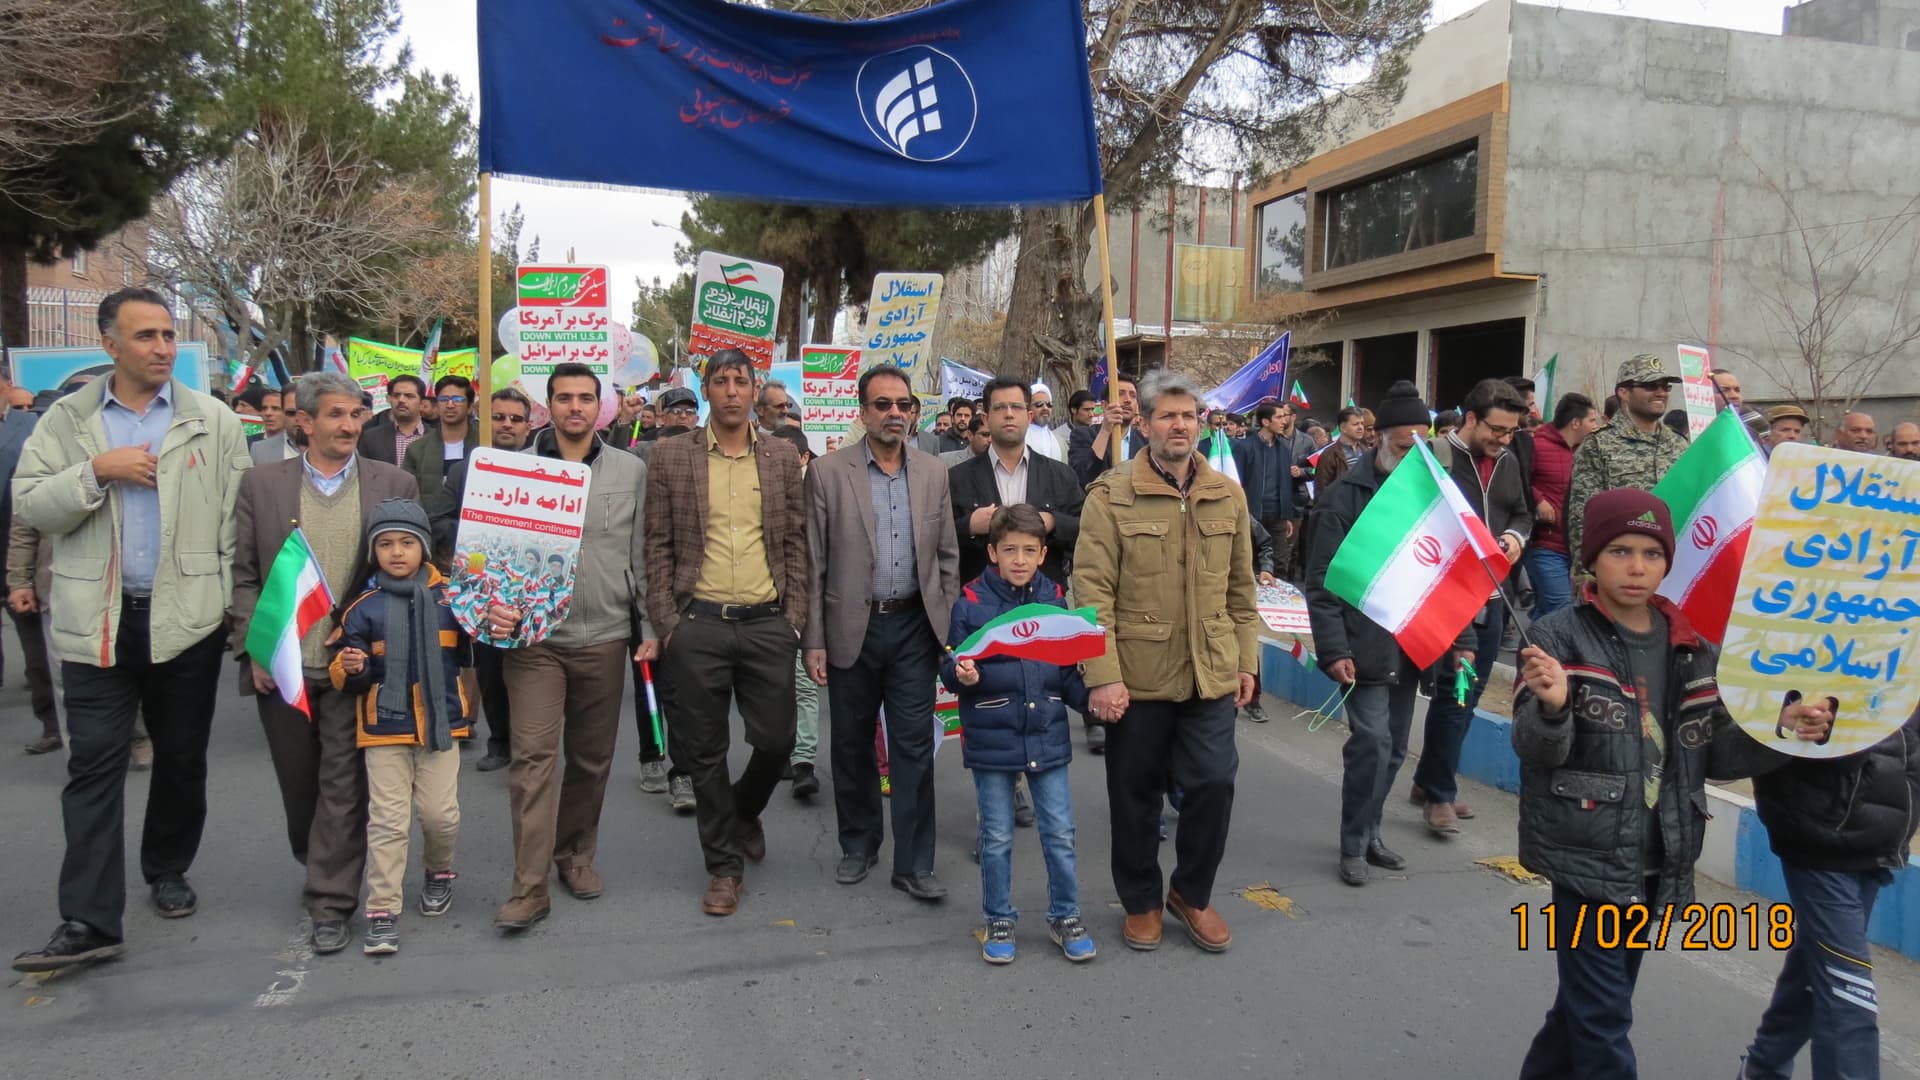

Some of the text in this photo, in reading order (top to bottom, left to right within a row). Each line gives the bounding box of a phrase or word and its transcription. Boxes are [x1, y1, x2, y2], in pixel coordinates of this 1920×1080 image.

[881, 279, 934, 302] استقلال
[519, 309, 608, 330] مرگ بر آمریکا
[879, 303, 927, 326] آزادی
[522, 332, 551, 341] DOWN
[554, 332, 578, 341] WITH
[868, 330, 927, 349] جمهوری
[521, 343, 608, 361] مرگ بر اسرائیل
[523, 365, 549, 374] DOWN
[805, 398, 825, 406] DOWN
[475, 457, 584, 487] نهضت
[1790, 463, 1920, 516] ستقلال
[536, 494, 582, 514] ادامه
[466, 511, 577, 536] The movement continues
[1627, 520, 1661, 530] adidas
[1784, 528, 1920, 581] آزادی
[1752, 580, 1920, 635] جمهوری
[1751, 634, 1902, 682] اسلامی
